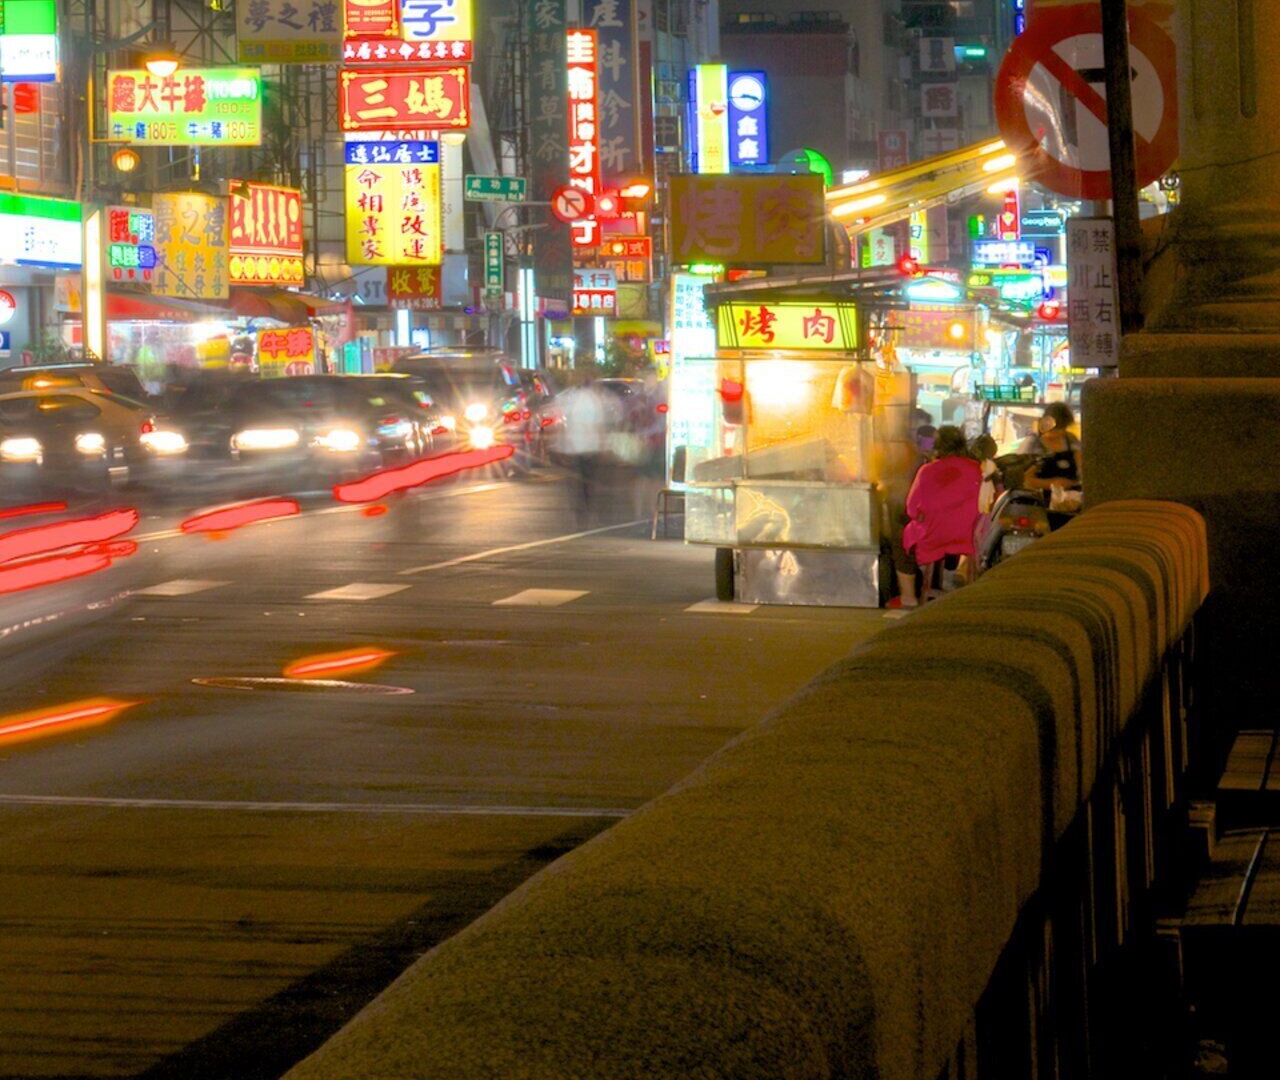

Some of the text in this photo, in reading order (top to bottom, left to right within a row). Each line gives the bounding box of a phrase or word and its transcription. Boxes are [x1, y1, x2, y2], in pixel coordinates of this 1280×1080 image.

[356, 76, 454, 119] 三媽
[677, 175, 821, 259] 烤肉
[739, 304, 837, 344] 烤肉
[1071, 228, 1091, 358] 柳川西路
[1091, 227, 1114, 358] 禁止右轉
[260, 329, 314, 358] 牛排
